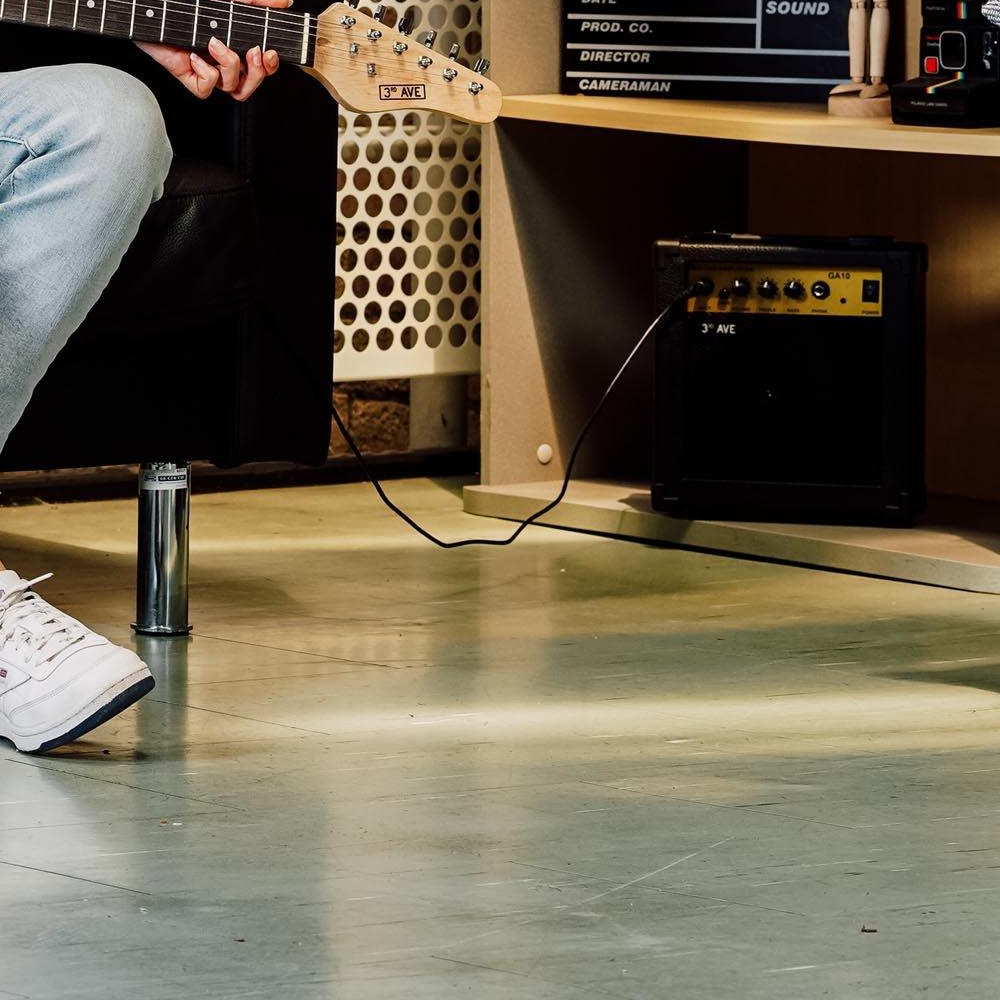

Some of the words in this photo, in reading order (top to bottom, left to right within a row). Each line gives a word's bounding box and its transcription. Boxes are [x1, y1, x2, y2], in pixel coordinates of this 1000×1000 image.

[766, 1, 830, 16] SOUND
[580, 21, 624, 33] PROD.
[628, 22, 653, 34] CO.
[580, 51, 650, 64] DIRECTOR
[579, 79, 671, 92] CAMERAMAN
[401, 87, 421, 98] AVE
[828, 272, 851, 280] GA10
[716, 324, 736, 334] AVE
